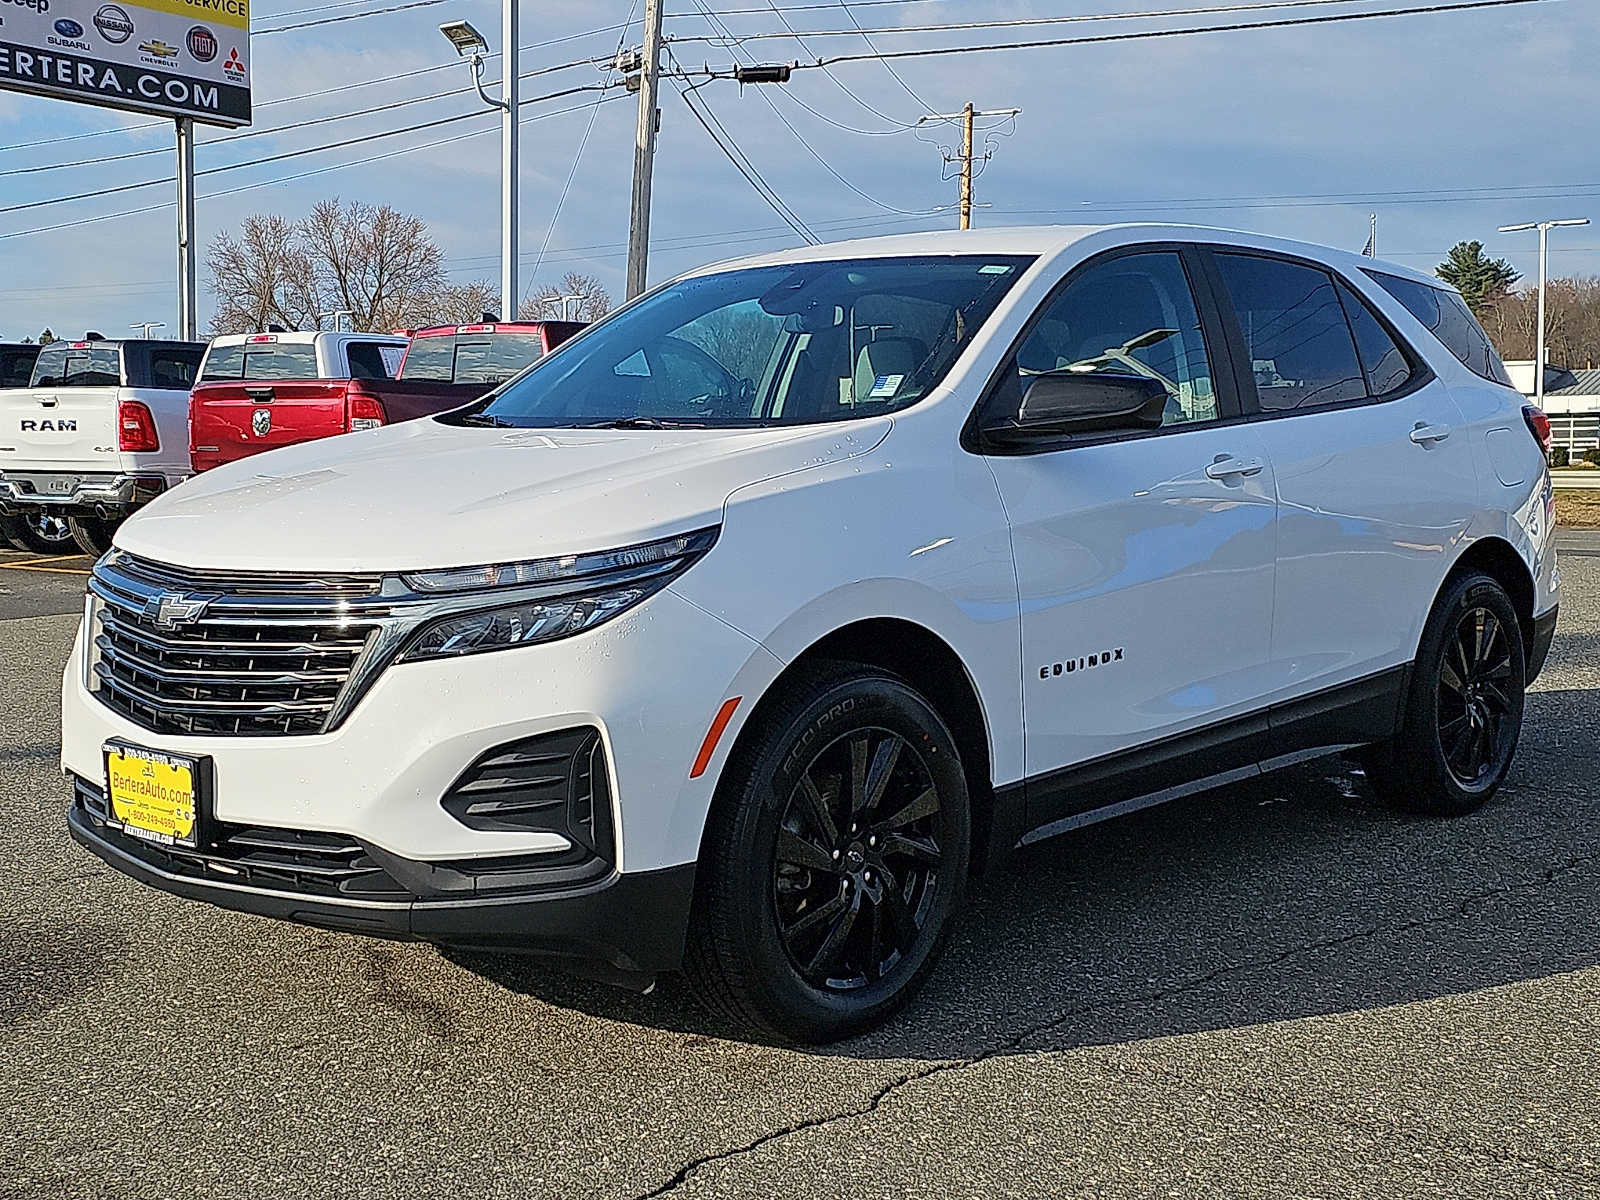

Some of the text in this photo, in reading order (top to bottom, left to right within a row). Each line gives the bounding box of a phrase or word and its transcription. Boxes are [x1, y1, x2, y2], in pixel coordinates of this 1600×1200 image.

[96, 17, 131, 31] NISSAN
[47, 36, 91, 51] SUBARU
[193, 36, 212, 54] FIAT
[140, 56, 179, 68] CHEVROLET
[21, 419, 77, 431] RAM
[1040, 648, 1123, 679] EQUINOX
[816, 697, 855, 728] PRO
[113, 771, 191, 806] BerteraAuto.com
